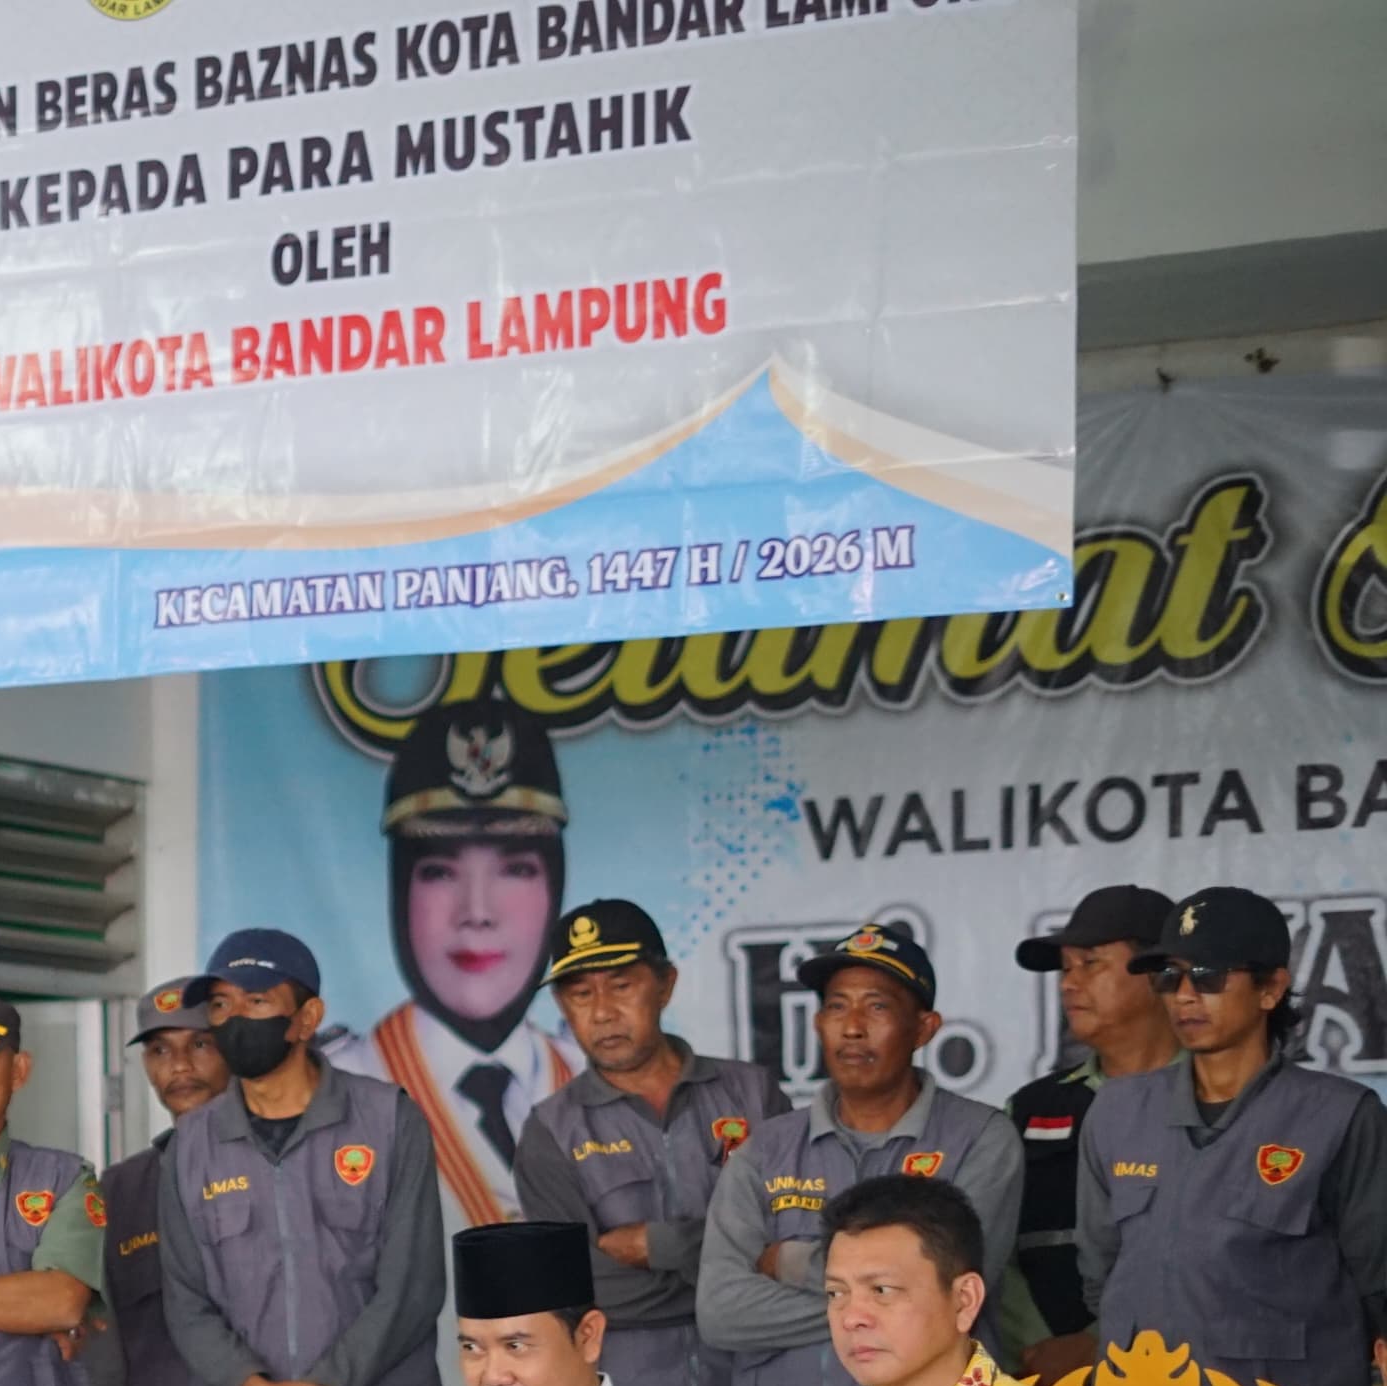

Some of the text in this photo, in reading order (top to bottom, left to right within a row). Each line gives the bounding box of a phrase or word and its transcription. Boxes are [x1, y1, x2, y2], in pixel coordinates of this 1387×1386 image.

[35, 60, 178, 131] BERAS
[195, 32, 378, 107] BAZNAS
[396, 16, 520, 79] KOTA
[537, 0, 745, 60] BANDAR
[227, 131, 372, 199] PARA
[395, 86, 692, 178] MUSTAHIK
[271, 222, 392, 286] OLEH
[231, 315, 445, 384] BANDAR
[467, 272, 727, 360] LAMPUNG
[154, 570, 386, 628] KECAMATAN
[587, 546, 681, 594] 1447
[686, 543, 723, 586] H
[729, 539, 751, 584] /
[756, 528, 865, 581] 2026
[872, 524, 916, 571] M
[804, 768, 1264, 861] WALIKOTA
